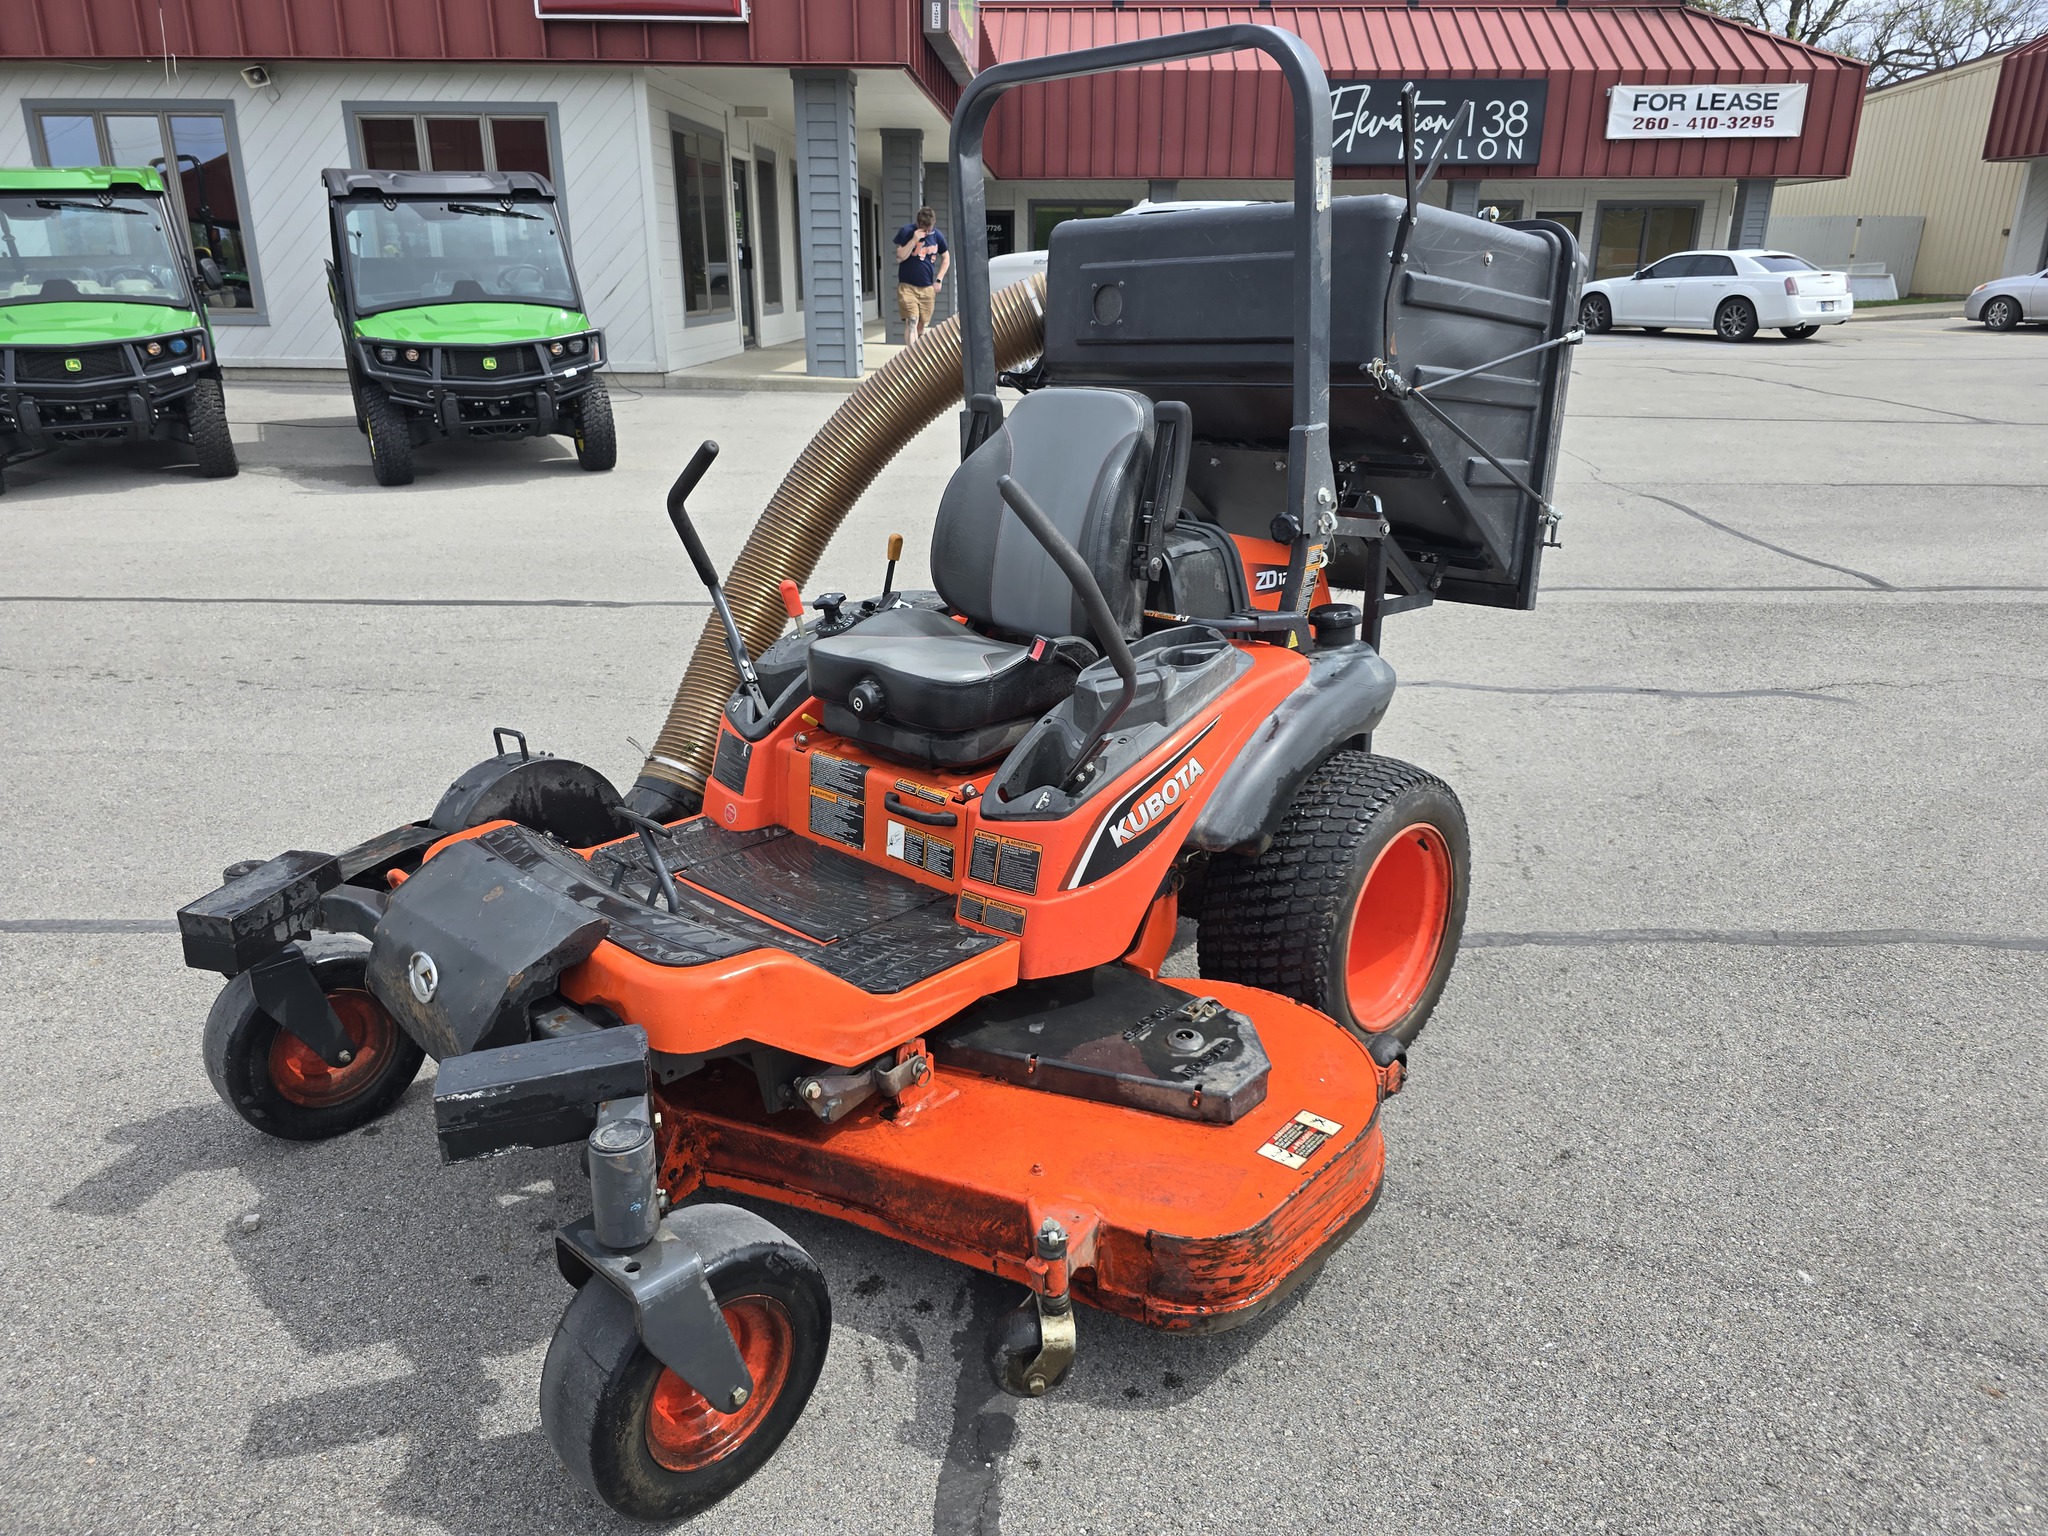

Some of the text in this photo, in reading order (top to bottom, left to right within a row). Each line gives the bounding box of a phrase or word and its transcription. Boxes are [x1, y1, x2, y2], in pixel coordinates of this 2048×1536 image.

[1633, 92, 1780, 111] FOR LEASE
[1468, 100, 1529, 138] 138
[1632, 117, 1669, 130] 260
[1686, 115, 1775, 130] 410-3295
[1108, 756, 1205, 848] KUBOTA
